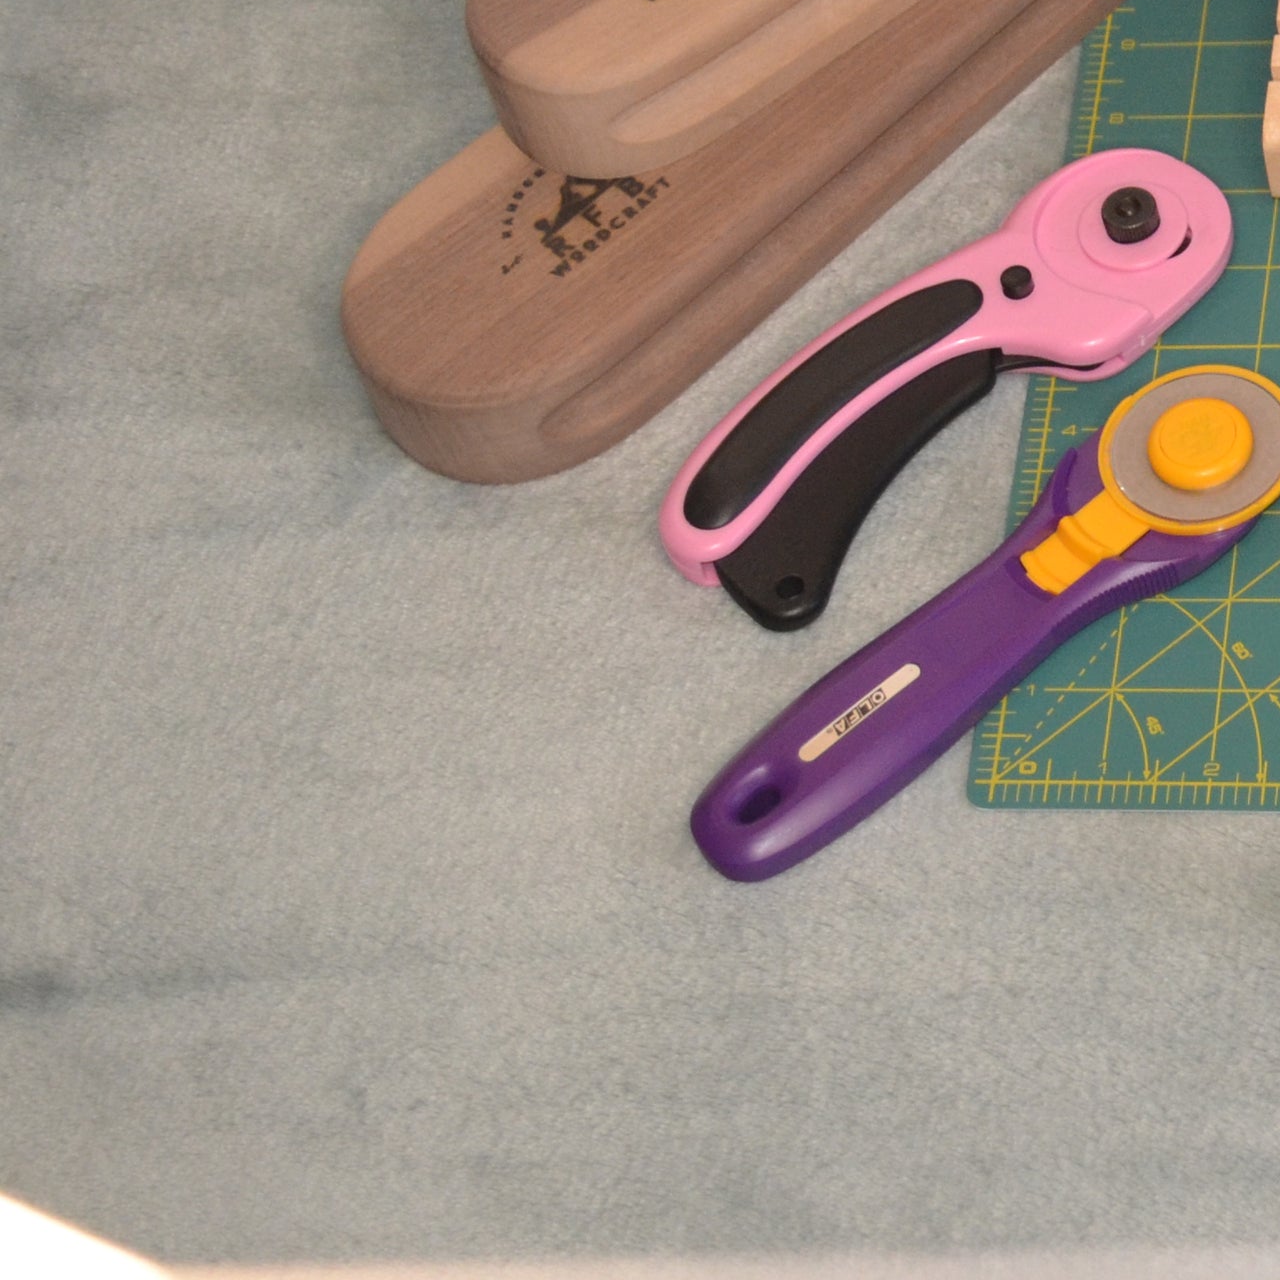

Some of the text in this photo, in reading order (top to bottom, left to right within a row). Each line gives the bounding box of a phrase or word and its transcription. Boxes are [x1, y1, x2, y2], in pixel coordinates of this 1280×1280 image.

[1061, 425, 1076, 436] 4
[833, 687, 887, 736] OLFA
[1203, 763, 1221, 776] 2
